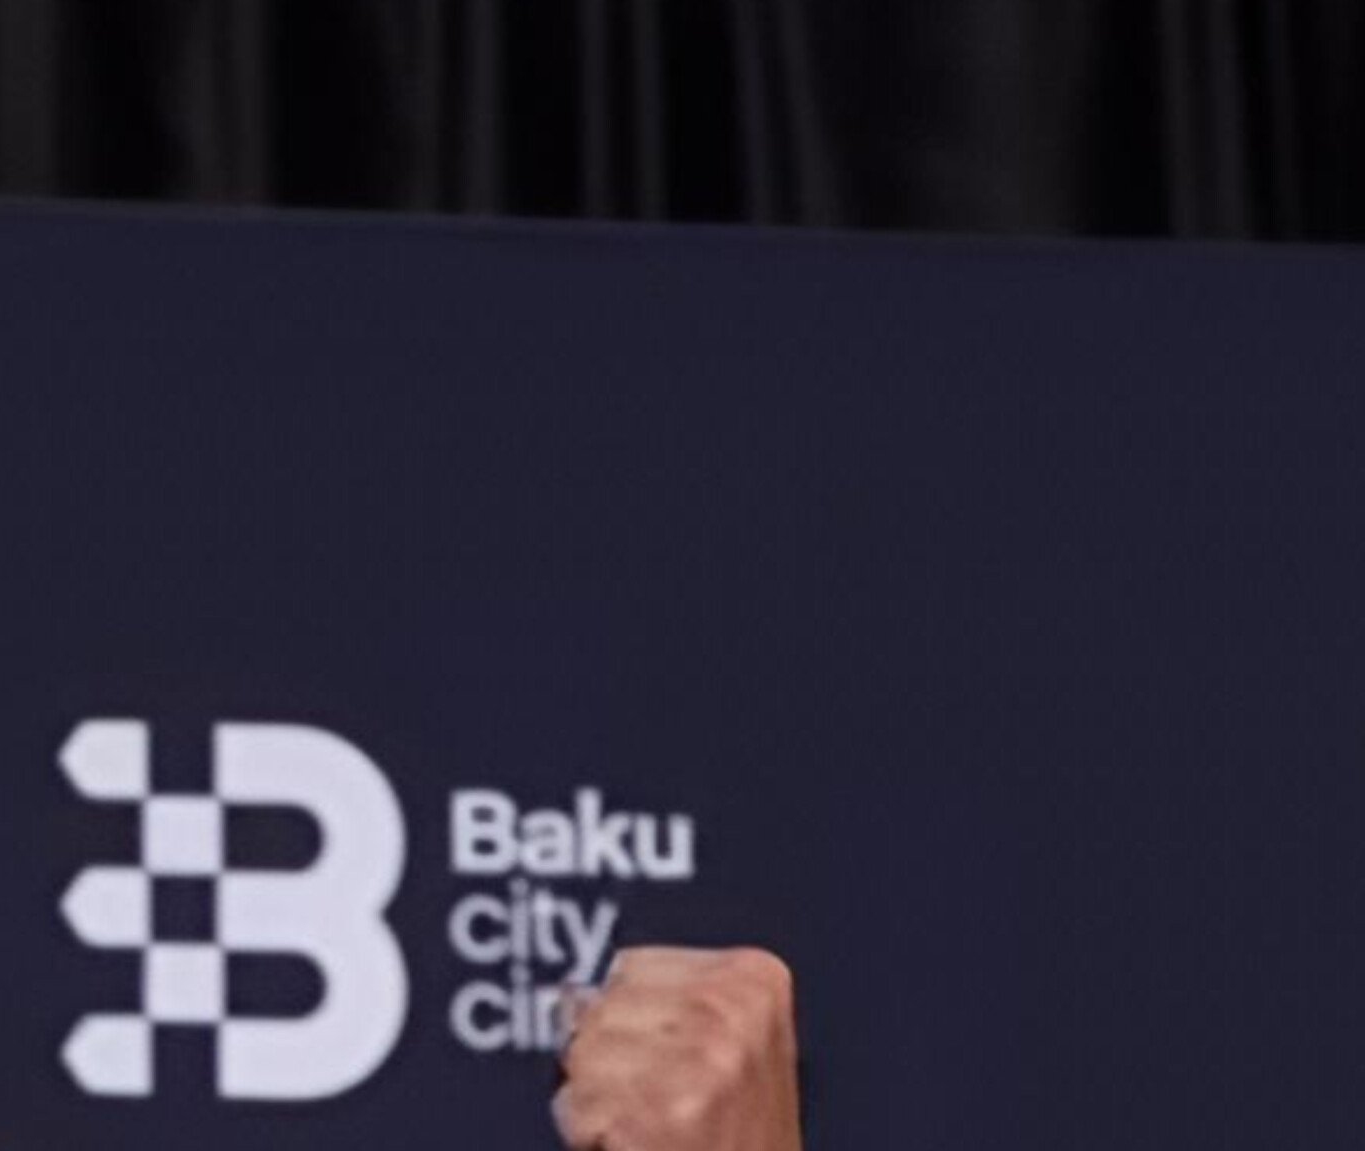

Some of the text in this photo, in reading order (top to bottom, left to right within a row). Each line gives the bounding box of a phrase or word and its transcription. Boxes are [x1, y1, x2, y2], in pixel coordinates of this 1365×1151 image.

[450, 787, 694, 879] Baku
[448, 878, 618, 984] city
[449, 964, 605, 1052] cir
